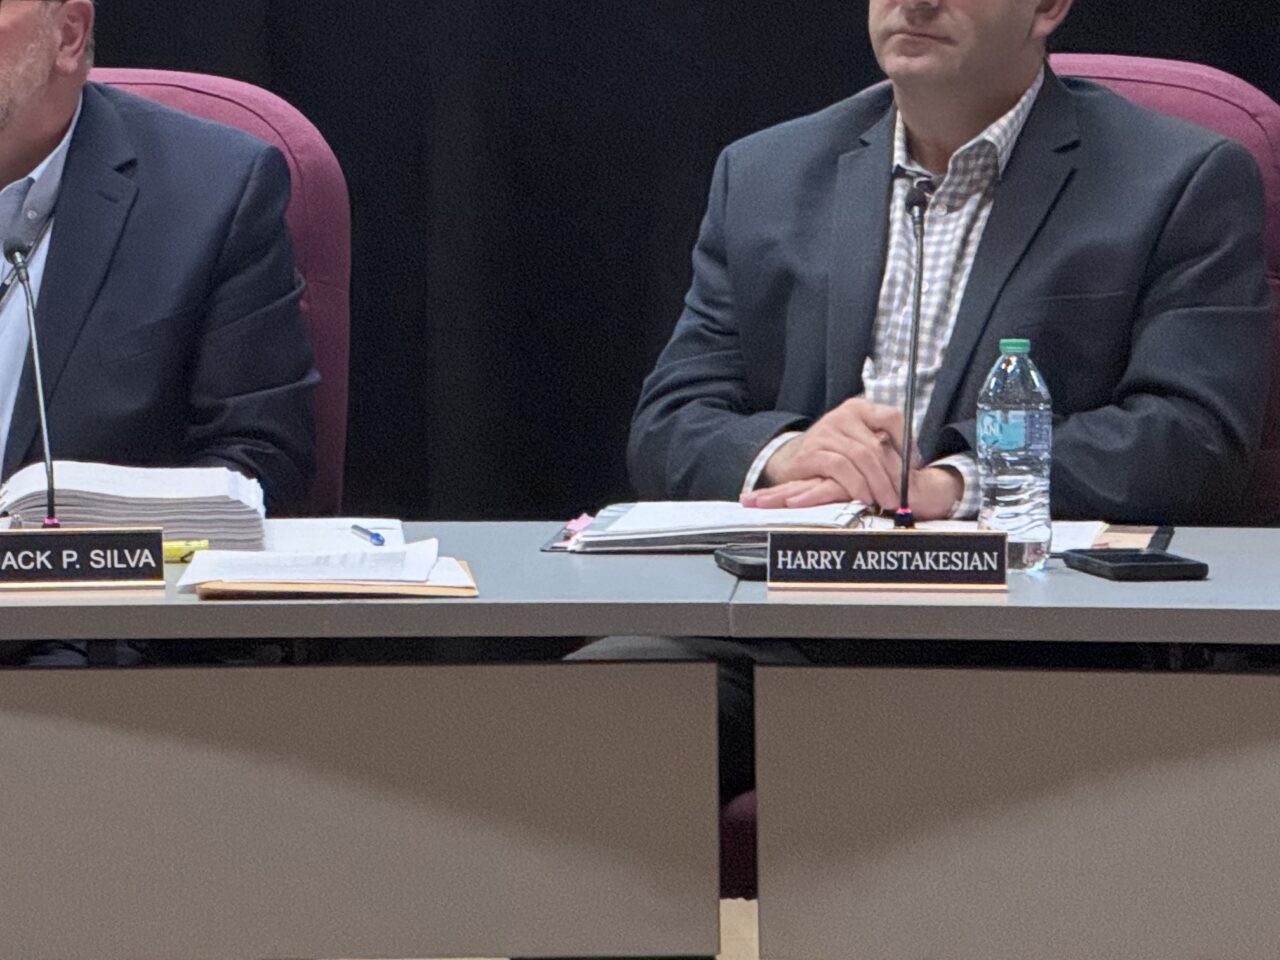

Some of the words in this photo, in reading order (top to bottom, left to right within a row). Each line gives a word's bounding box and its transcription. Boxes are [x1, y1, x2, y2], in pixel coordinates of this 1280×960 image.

[62, 549, 80, 569] P.
[89, 549, 156, 569] SILVA
[777, 550, 845, 570] HARRY
[853, 551, 998, 571] ARISTAKESIAN
